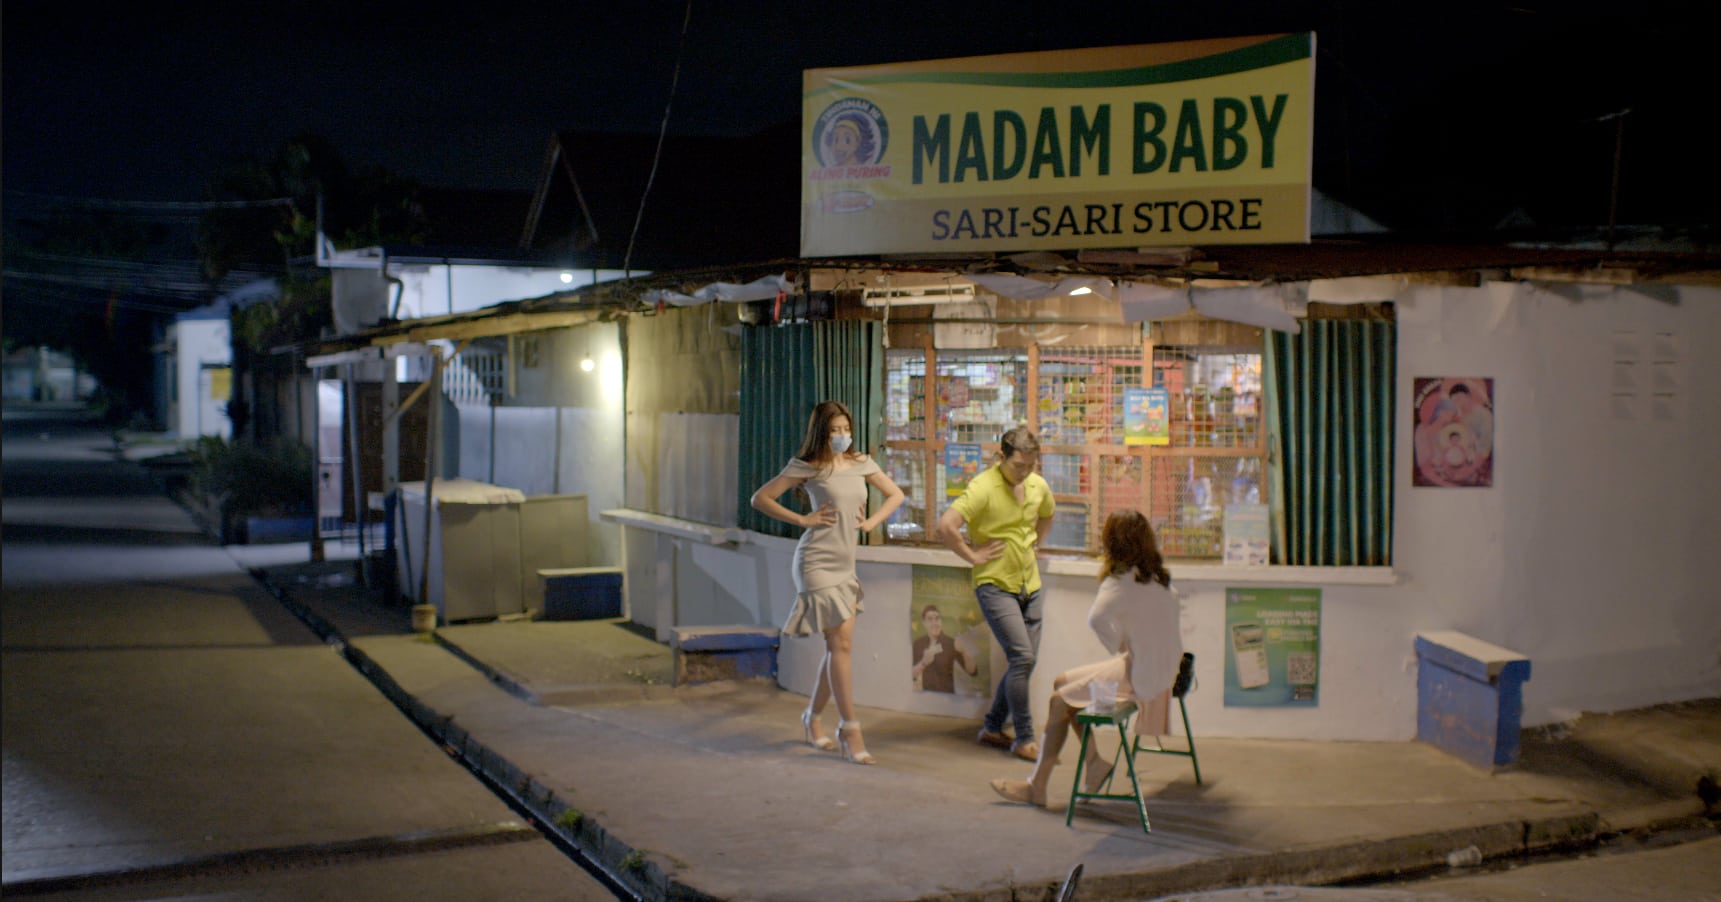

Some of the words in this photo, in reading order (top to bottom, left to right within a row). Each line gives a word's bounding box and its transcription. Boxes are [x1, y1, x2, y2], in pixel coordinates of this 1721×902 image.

[912, 104, 1111, 185] MADAM
[1131, 94, 1289, 174] BABY
[847, 165, 891, 178] PURING
[931, 204, 1122, 241] SARI-SARI
[1133, 198, 1262, 233] STORE
